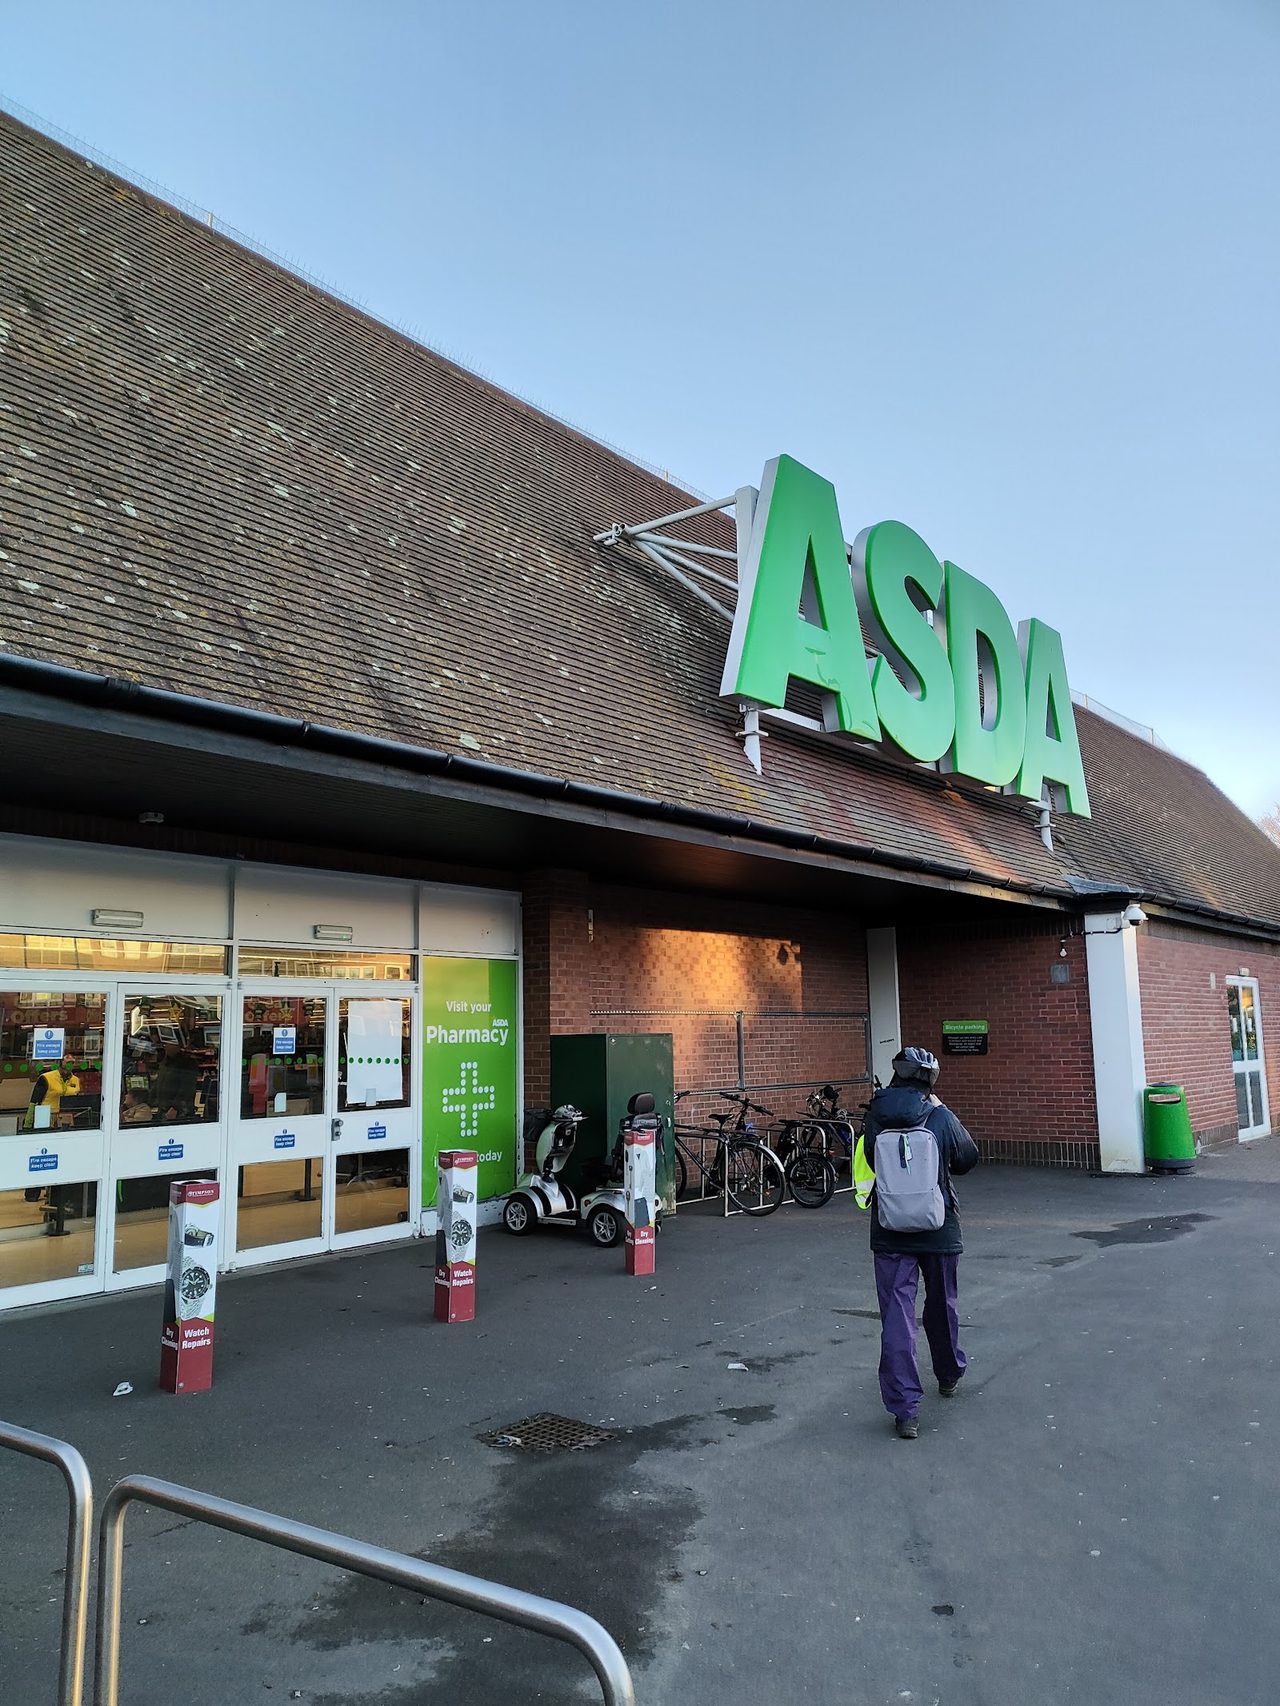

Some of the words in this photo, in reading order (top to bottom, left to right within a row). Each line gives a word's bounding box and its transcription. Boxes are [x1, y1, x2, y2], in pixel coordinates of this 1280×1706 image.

[720, 454, 1092, 819] ASDA
[446, 1001, 468, 1012] Visit
[470, 1003, 492, 1014] your
[492, 1018, 508, 1027] ASDA
[426, 1025, 508, 1046] Pharmacy
[477, 1151, 502, 1163] today
[454, 1269, 473, 1278] Watch
[452, 1277, 474, 1287] Repairs
[184, 1326, 210, 1339] Watch
[181, 1337, 211, 1349] Repairs
